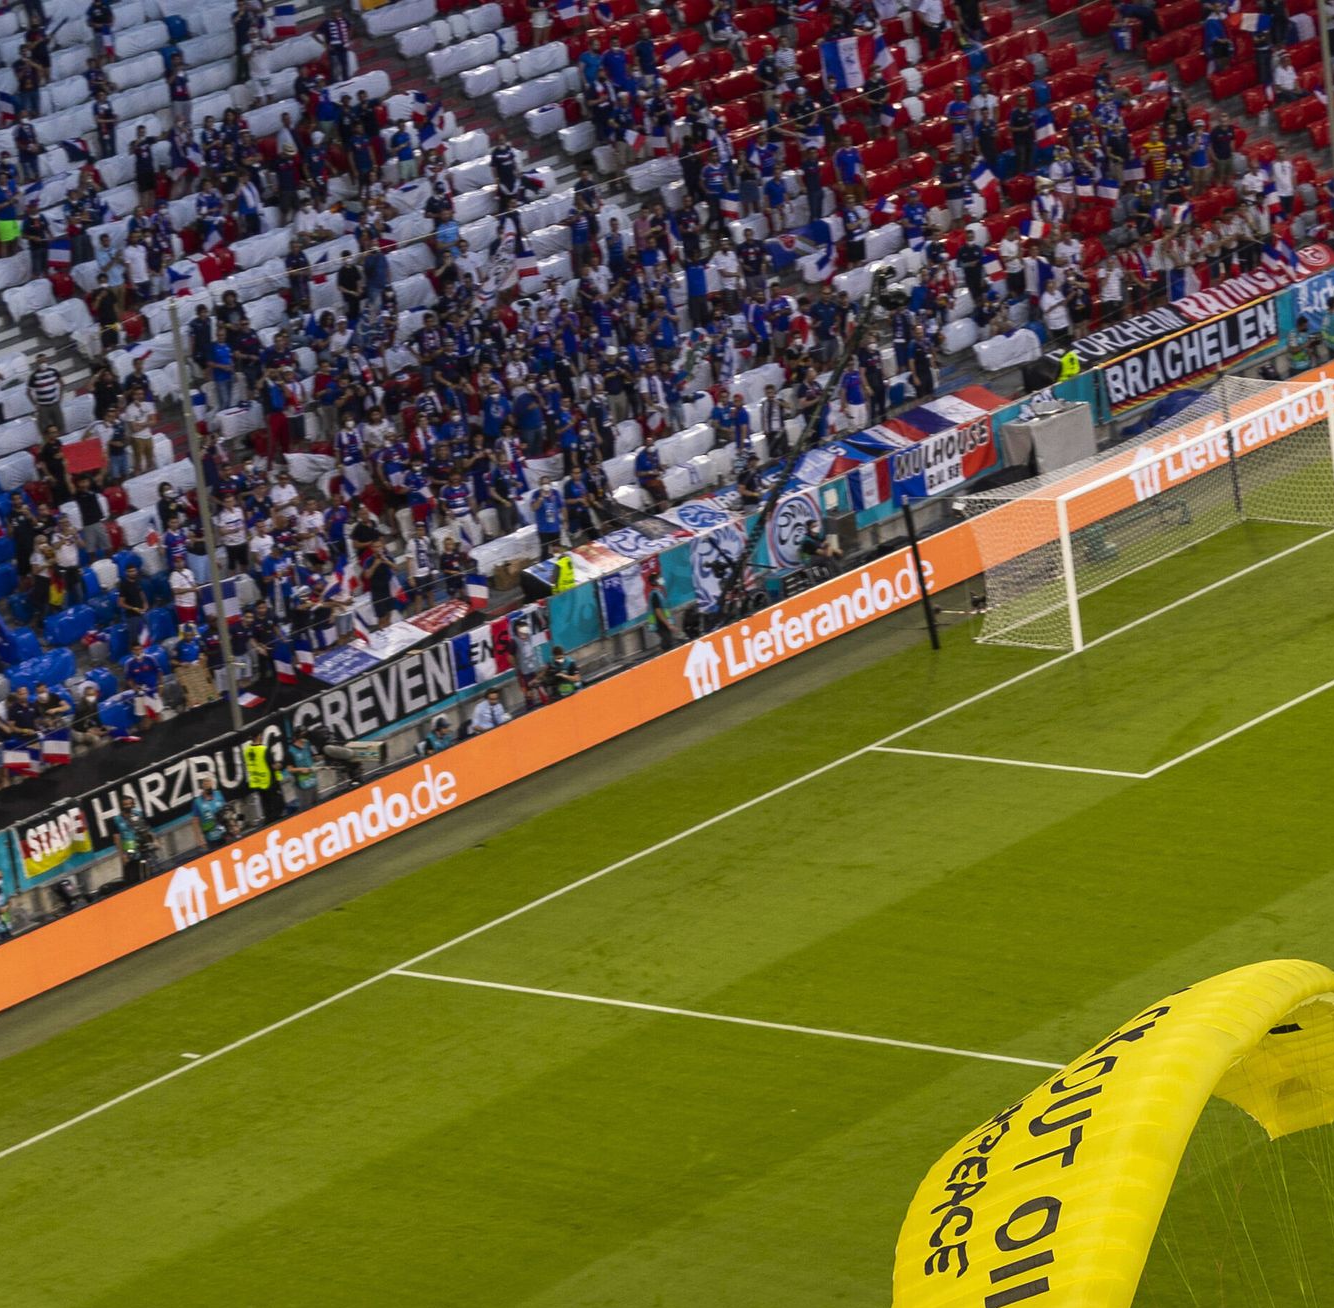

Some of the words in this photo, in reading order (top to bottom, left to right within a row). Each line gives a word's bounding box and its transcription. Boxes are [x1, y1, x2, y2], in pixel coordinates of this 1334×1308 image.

[1105, 299, 1278, 404] BRACHELEN
[893, 415, 989, 482] MULHOUSE
[724, 549, 934, 677] Lieferando.de
[207, 764, 458, 908] Lieferando.de
[1013, 1055, 1119, 1171] OUT
